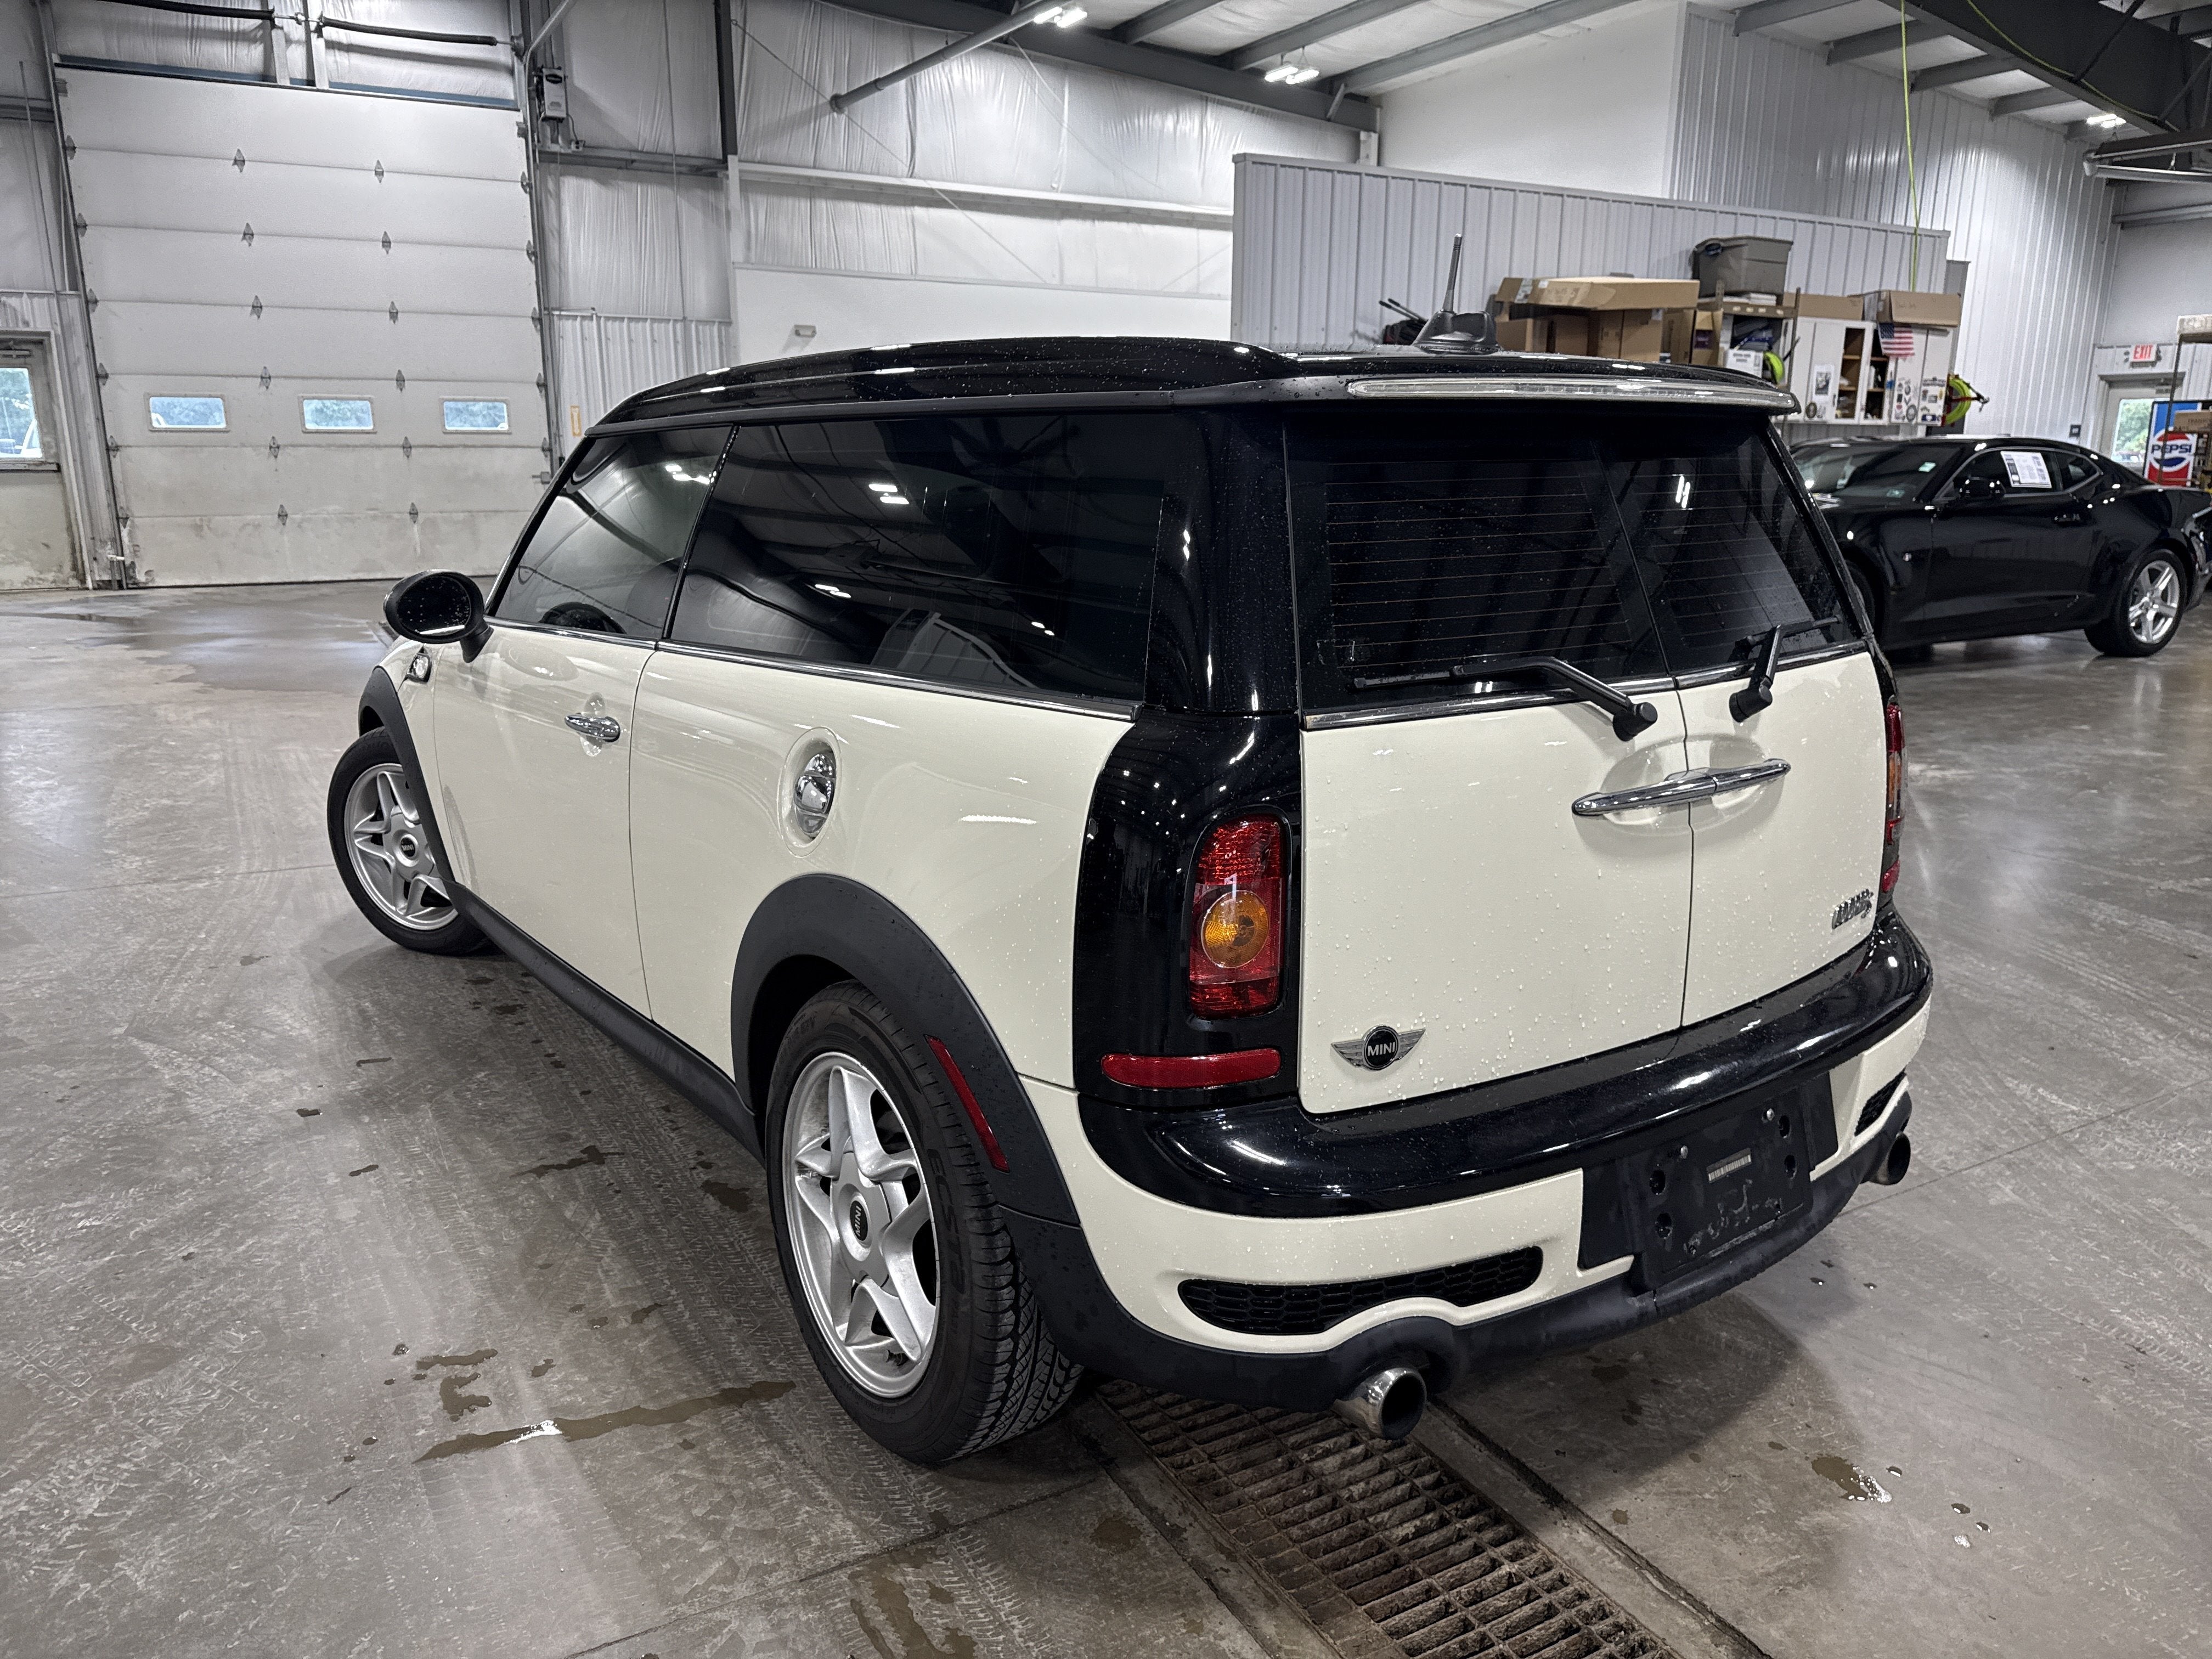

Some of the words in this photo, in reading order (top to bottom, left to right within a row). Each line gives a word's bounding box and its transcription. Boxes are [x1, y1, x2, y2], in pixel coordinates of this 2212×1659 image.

[2133, 344, 2153, 359] EXIT
[2151, 443, 2192, 454] PEPSI
[1367, 1041, 1396, 1057] MINI
